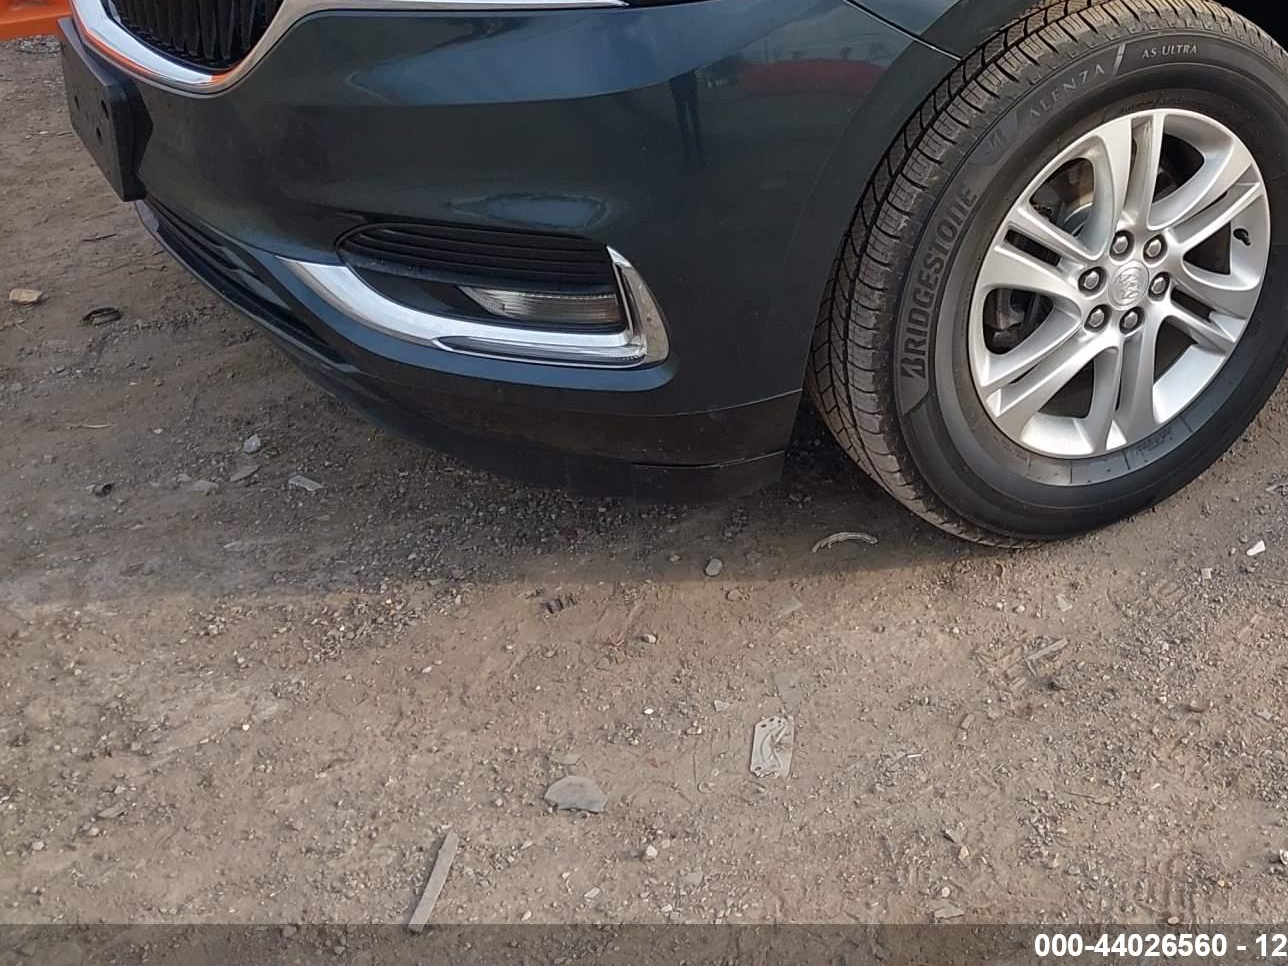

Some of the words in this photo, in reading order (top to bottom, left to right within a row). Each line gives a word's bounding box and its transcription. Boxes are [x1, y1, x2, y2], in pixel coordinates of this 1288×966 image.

[1028, 63, 1106, 119] ALENZA
[1141, 47, 1158, 59] AS
[1161, 43, 1198, 56] ULTRA
[901, 187, 977, 380] BRIDGESTONE
